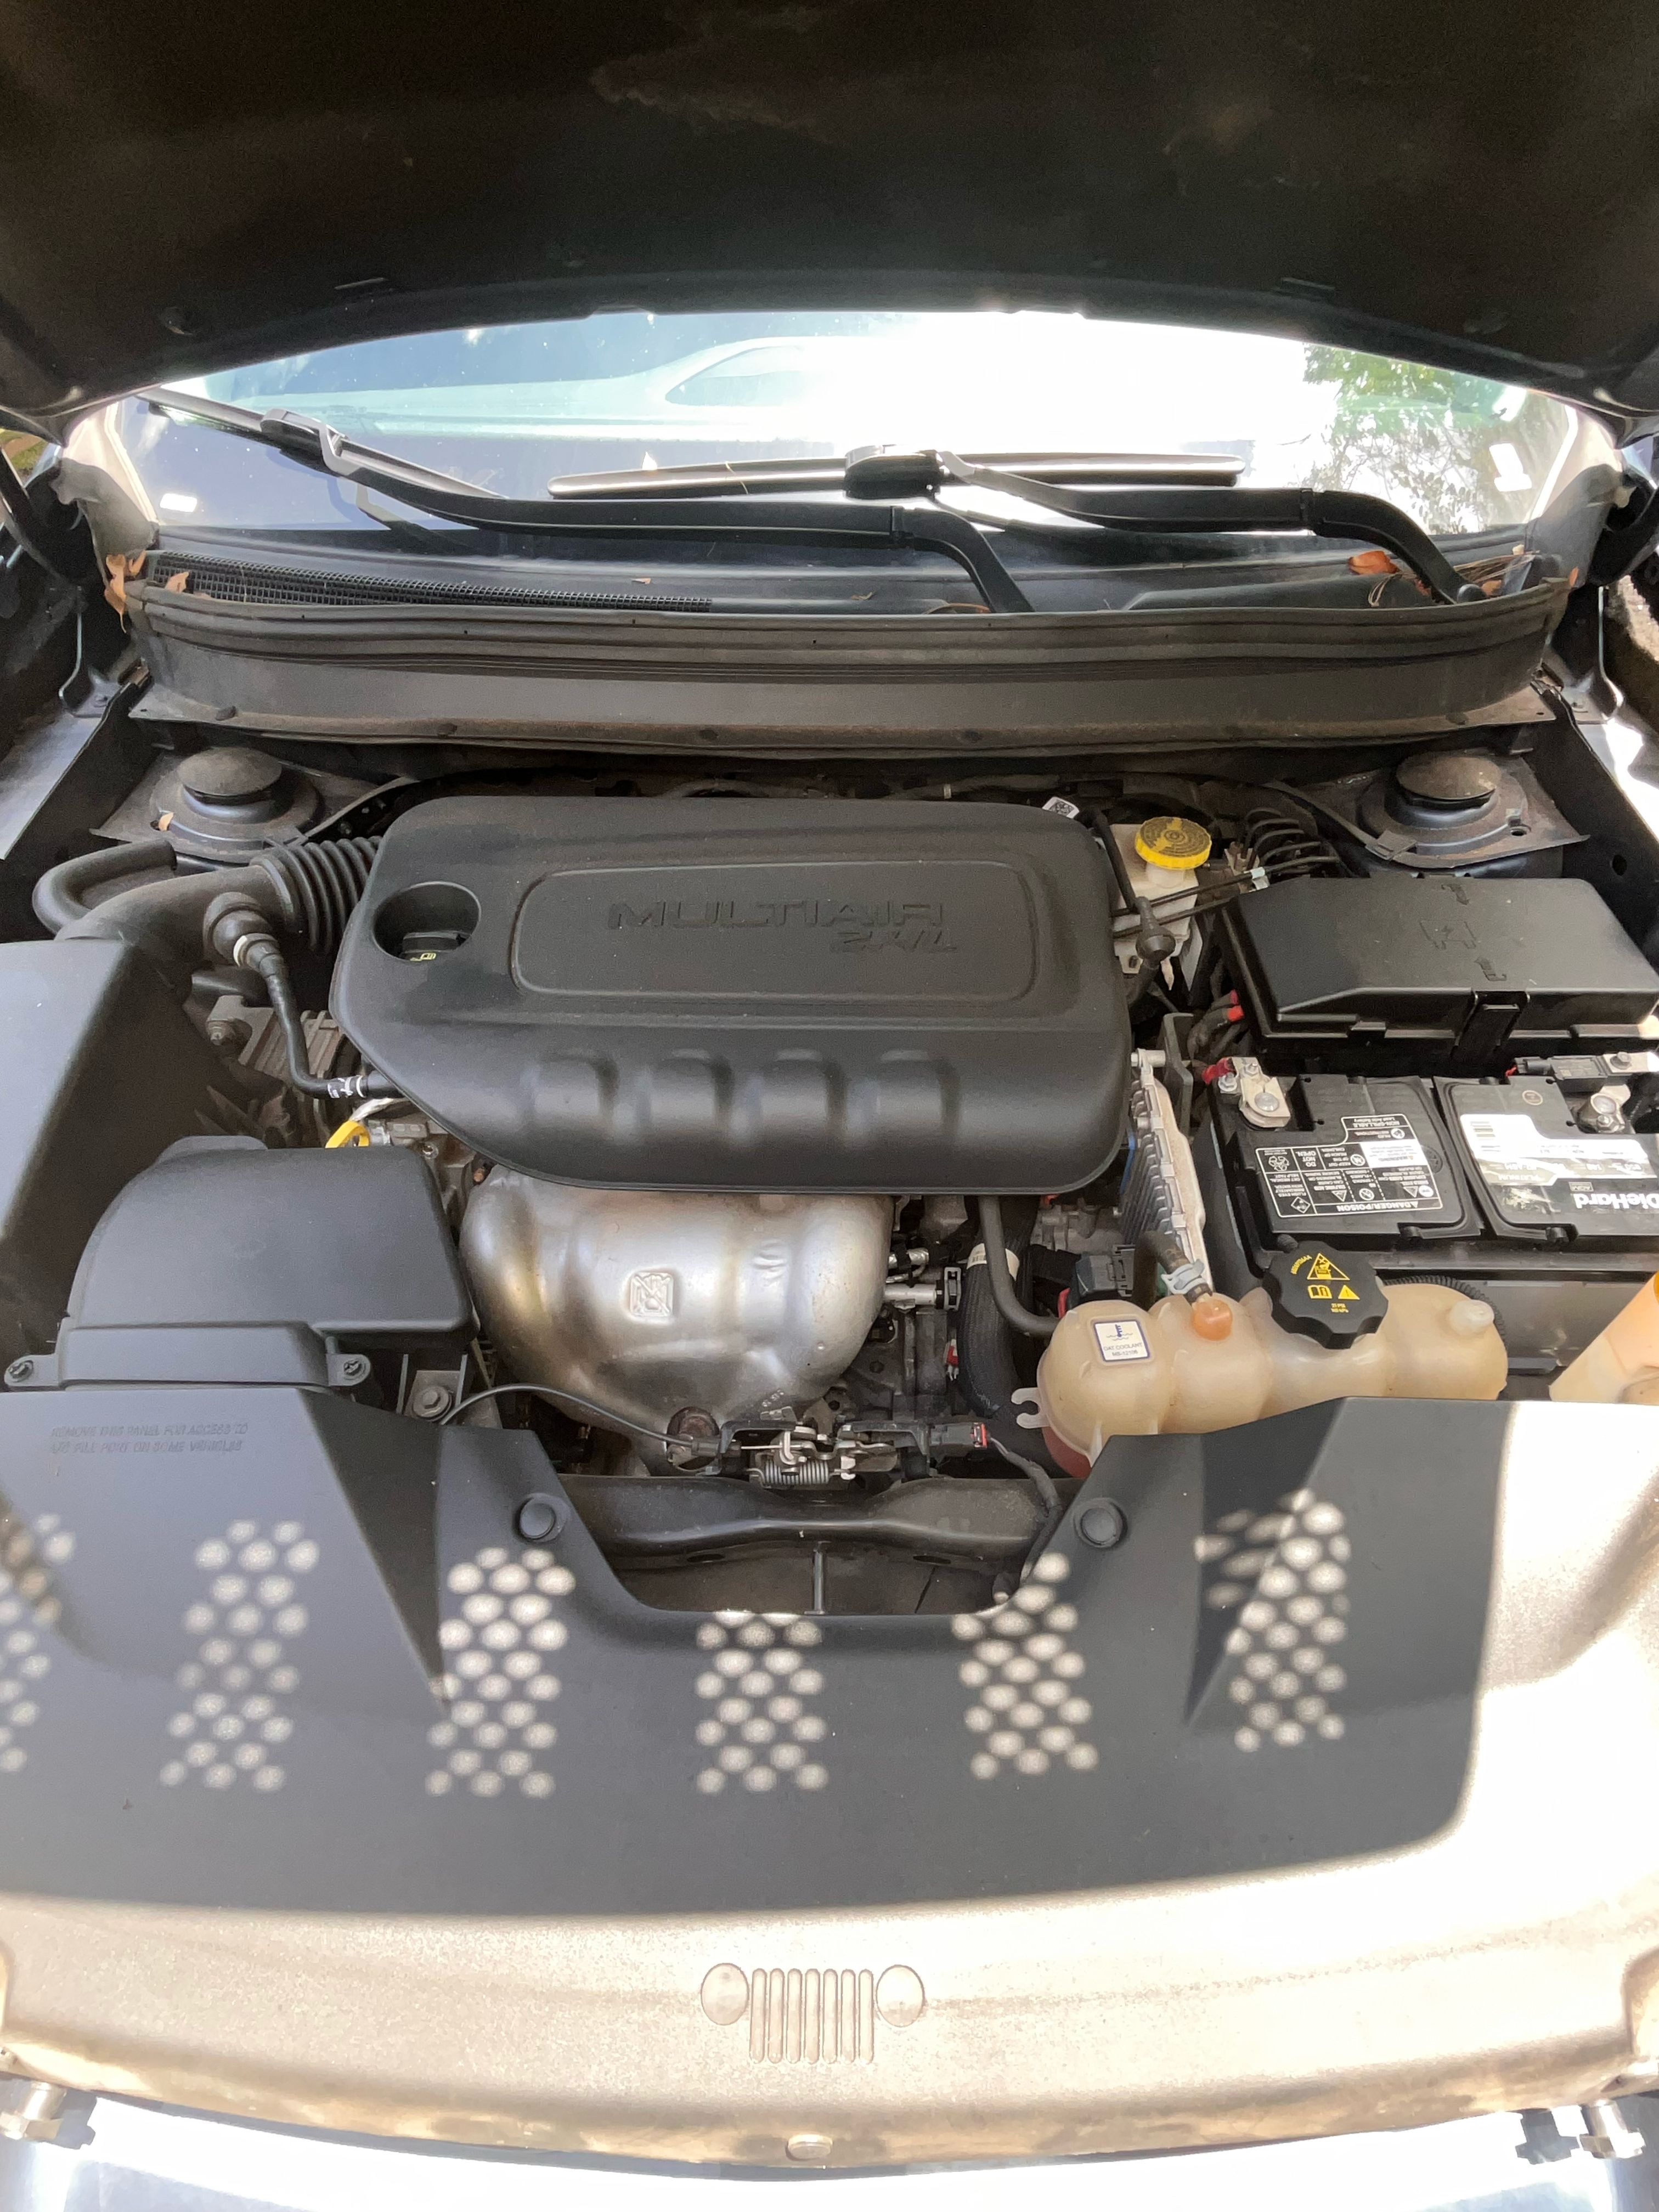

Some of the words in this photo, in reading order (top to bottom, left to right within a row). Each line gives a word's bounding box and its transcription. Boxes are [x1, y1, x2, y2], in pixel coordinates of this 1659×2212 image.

[607, 900, 943, 929] MULTIAIR
[1337, 1201, 1412, 1212] DANGER/POISON
[1572, 1193, 1659, 1209] DieHard
[188, 1423, 231, 1435] ACCESS
[153, 1441, 184, 1452] SOME
